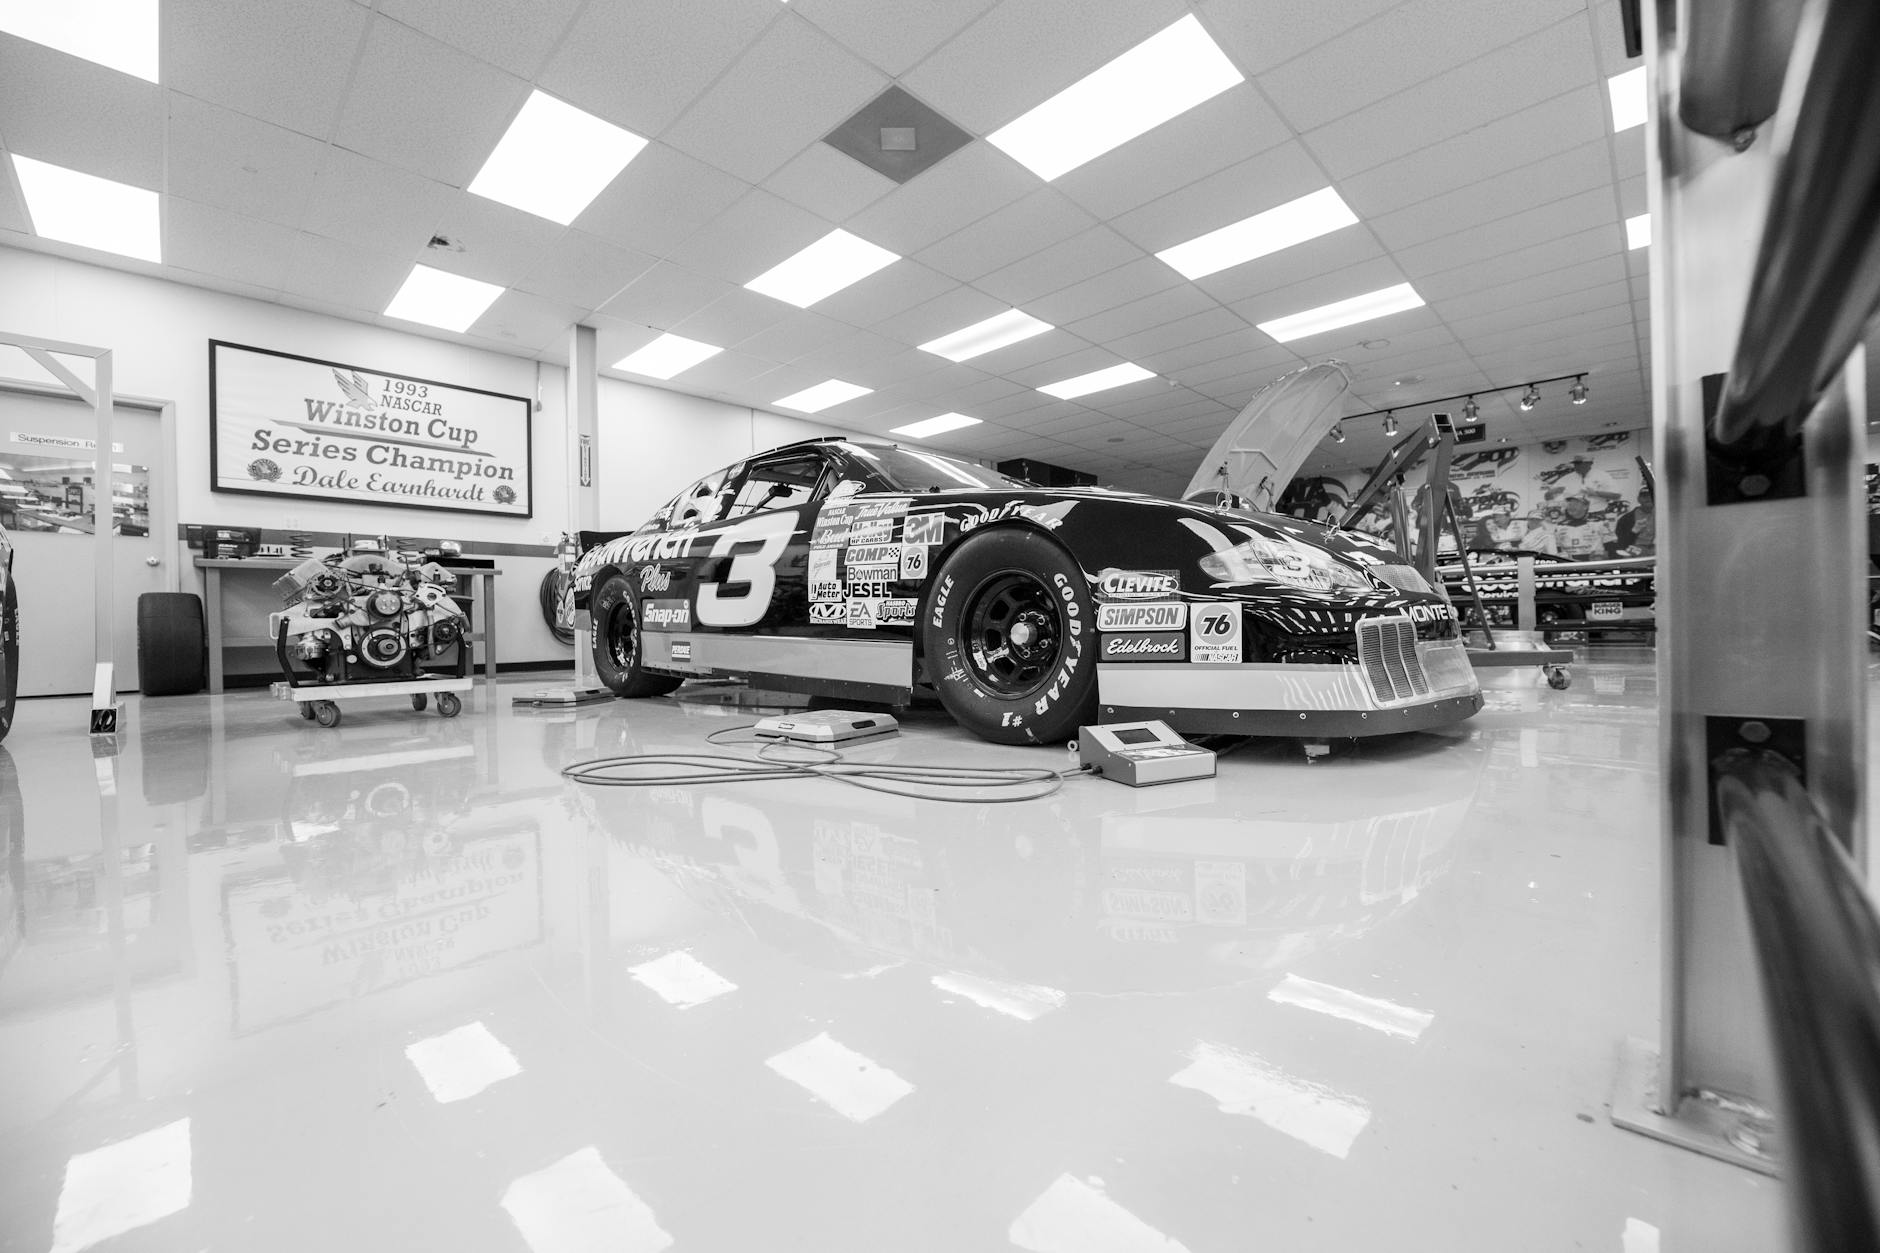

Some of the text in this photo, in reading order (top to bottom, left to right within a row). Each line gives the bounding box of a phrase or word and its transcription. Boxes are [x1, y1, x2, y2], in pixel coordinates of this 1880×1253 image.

[382, 378, 430, 398] 1993
[381, 394, 443, 416] NASCAR
[303, 398, 479, 448] Winston Cup
[18, 433, 80, 447] Suspension
[251, 429, 515, 480] Series Champion
[292, 464, 360, 490] Dale
[366, 473, 485, 501] Earnhardt
[904, 514, 944, 545] 3M
[846, 546, 889, 562] COMP
[906, 554, 922, 570] 76
[640, 563, 672, 592] Plus
[696, 510, 801, 628] 3
[848, 567, 897, 581] Bowman
[817, 582, 837, 590] Auto
[844, 582, 891, 598] JESEL
[1104, 573, 1174, 593] CLEVITE
[817, 589, 841, 599] Meter
[932, 574, 955, 629] EAGLE
[643, 602, 690, 628] Snap-on
[875, 602, 916, 621] Sports
[1399, 603, 1448, 622] MONTE
[849, 618, 872, 626] SPORTS
[1203, 614, 1231, 635] 76
[1034, 573, 1082, 715] GOODYEAR
[1107, 638, 1179, 655] Edelbrock
